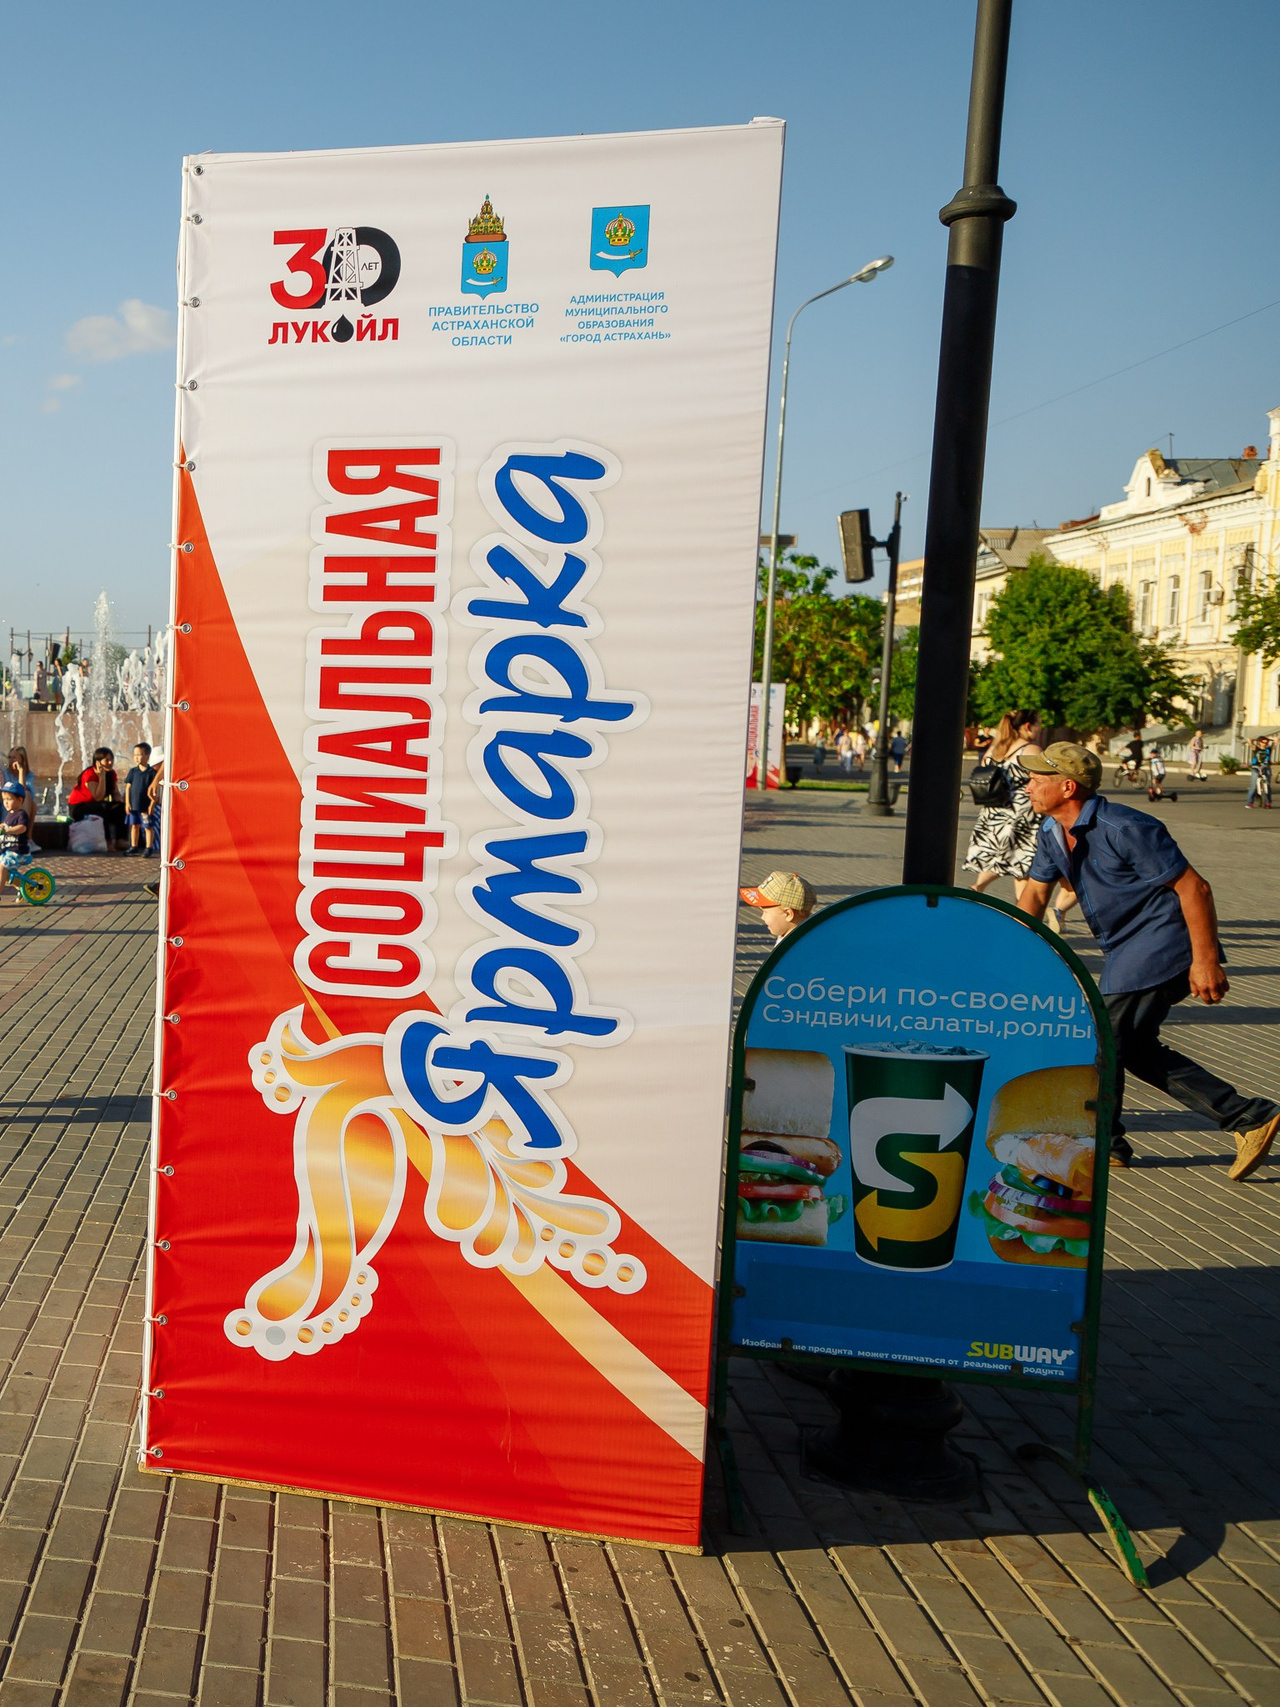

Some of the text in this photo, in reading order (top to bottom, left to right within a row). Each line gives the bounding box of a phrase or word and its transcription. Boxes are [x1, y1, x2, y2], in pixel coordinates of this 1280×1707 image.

[270, 226, 401, 309] 30
[361, 262, 379, 270] ЛЕТ
[569, 292, 665, 304] АДМИНИСТРАЦИЯ
[428, 303, 539, 317] ПРАВИТЕЛЬСТВО
[565, 304, 669, 317] МУНИЦИПАЛЬНОГО
[431, 316, 535, 331] АСТРАХАНСКОЙ
[577, 318, 655, 330] ОБРАЗОВАНИЯ
[451, 335, 513, 347] ОБЛАСТИ
[559, 331, 671, 344] «ГОРОД АСТРАХАНЬ»
[308, 446, 446, 989] СОЦИАЛЬНАЯ
[400, 451, 634, 1149] Ярмарка
[763, 975, 1086, 1020] Собери по-своему!
[808, 1345, 853, 1356] продукта
[857, 1350, 889, 1359] может
[891, 1354, 946, 1365] отличаться
[1022, 1366, 1065, 1376] родукта
[966, 1341, 1075, 1366] SUBWAY
